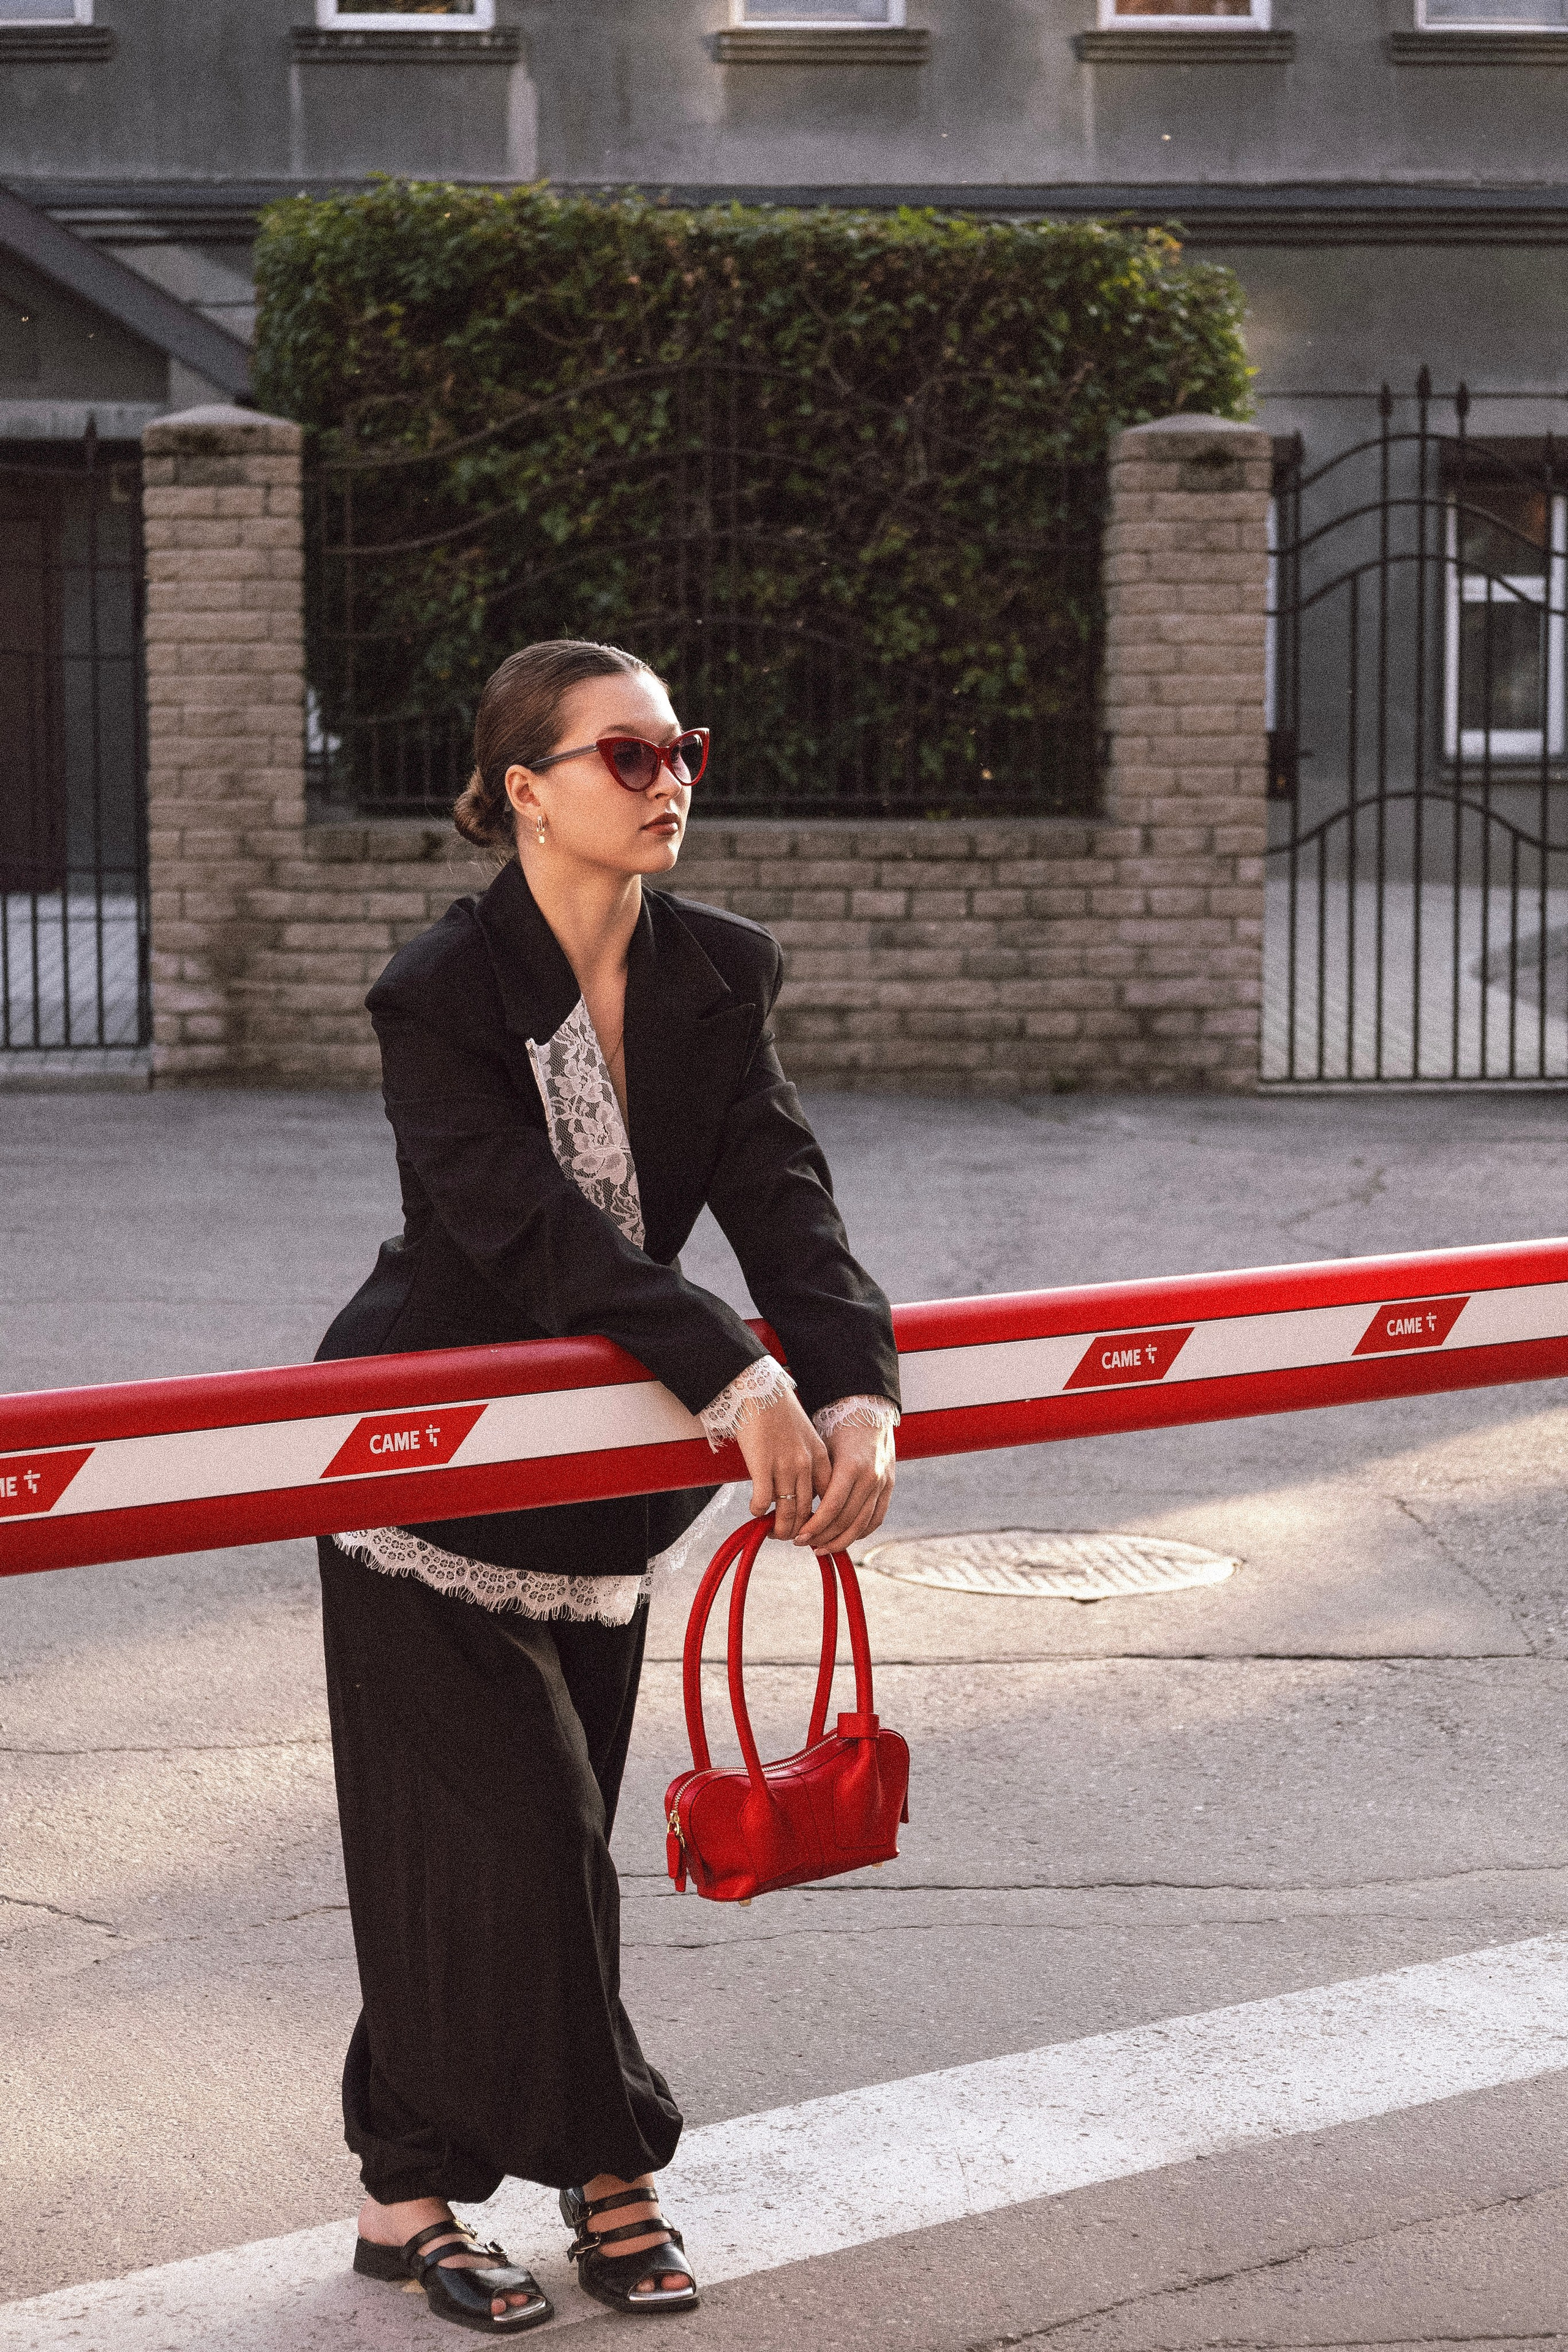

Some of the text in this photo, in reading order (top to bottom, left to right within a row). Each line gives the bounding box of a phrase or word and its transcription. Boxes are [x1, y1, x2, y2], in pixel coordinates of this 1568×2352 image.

[1387, 1317, 1423, 1336] CAME
[1102, 1349, 1141, 1370] CAME
[369, 1430, 420, 1455] CAME
